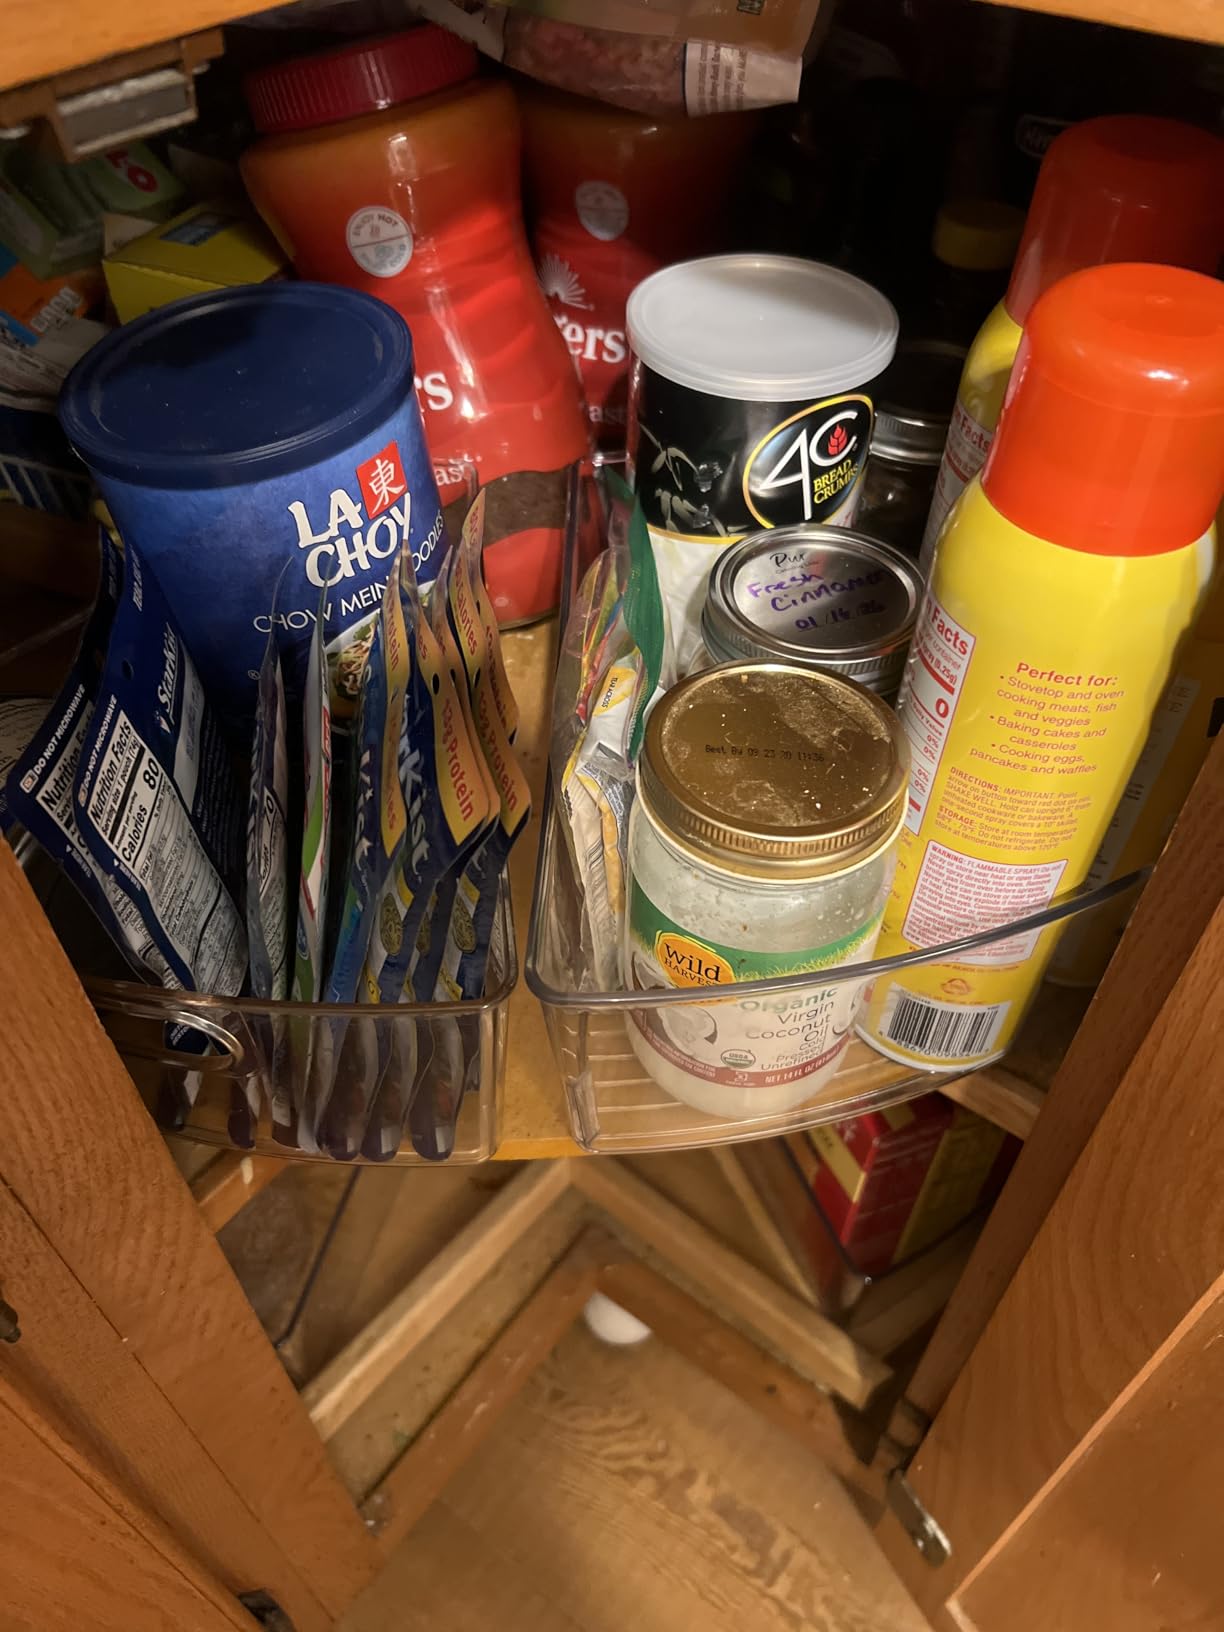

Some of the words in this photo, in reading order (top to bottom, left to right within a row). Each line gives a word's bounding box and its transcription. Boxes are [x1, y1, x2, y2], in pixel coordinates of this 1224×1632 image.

[757, 411, 858, 520] 4C
[813, 459, 852, 492] BREAD
[368, 458, 405, 515] 東
[813, 463, 859, 504] CRUMBS
[288, 489, 362, 549] LA
[306, 492, 411, 587] CHOY
[253, 603, 332, 632] CHOW
[412, 510, 444, 572] OODLES
[747, 573, 825, 598] Fresh
[931, 605, 969, 655] Facts
[158, 621, 177, 713] StarKist
[1016, 662, 1082, 686] Perfect
[1087, 675, 1118, 687] for:
[997, 688, 1046, 711] cooking
[1095, 702, 1117, 713] fish
[1007, 676, 1064, 699] Stovetop
[1067, 689, 1092, 700] and
[1095, 690, 1124, 699] oven
[935, 697, 949, 719] 0
[1013, 708, 1039, 721] and
[1042, 715, 1091, 727] veggies
[34, 759, 47, 776] DO
[43, 736, 59, 758] NOT
[55, 684, 86, 736] MICROWAVE
[94, 694, 117, 752] MICROWAVE
[997, 715, 1040, 737] Baking
[1043, 728, 1080, 738] cakes
[1083, 727, 1107, 738] and
[705, 744, 727, 754] Best
[923, 746, 935, 761] 0%
[927, 734, 938, 749] 0%
[999, 744, 1050, 764] Cooking
[1053, 754, 1085, 764] eggs,
[1009, 735, 1077, 750] casseroles
[87, 752, 99, 773] NOT
[90, 759, 118, 826] Nutrition
[112, 721, 132, 758] Facts
[488, 730, 519, 811] Protein
[969, 748, 1027, 771] pancakes
[1031, 764, 1054, 774] and
[1058, 764, 1098, 775] waffles
[41, 747, 80, 812] Nutrition
[84, 774, 93, 787] DO
[101, 804, 116, 836] Serving
[113, 788, 121, 805] size
[121, 756, 132, 783] pouch
[128, 736, 140, 759] (74g)
[447, 738, 475, 822] Protein
[914, 780, 926, 793] 0%
[917, 768, 929, 782] 0%
[950, 766, 1000, 793] DIRECTIONS:
[946, 781, 971, 798] SHAKE
[969, 785, 980, 793] on
[121, 804, 148, 862] Calories
[143, 757, 160, 791] 80
[939, 805, 977, 827] STORAGE:
[931, 845, 966, 864] WARNING:
[967, 860, 1012, 874] FLAMMABLE
[664, 943, 721, 983] Wild
[739, 987, 838, 1014] Organic
[778, 1001, 835, 1025] Virgin
[745, 1014, 831, 1040] Coconut
[804, 1024, 828, 1042] Oil
